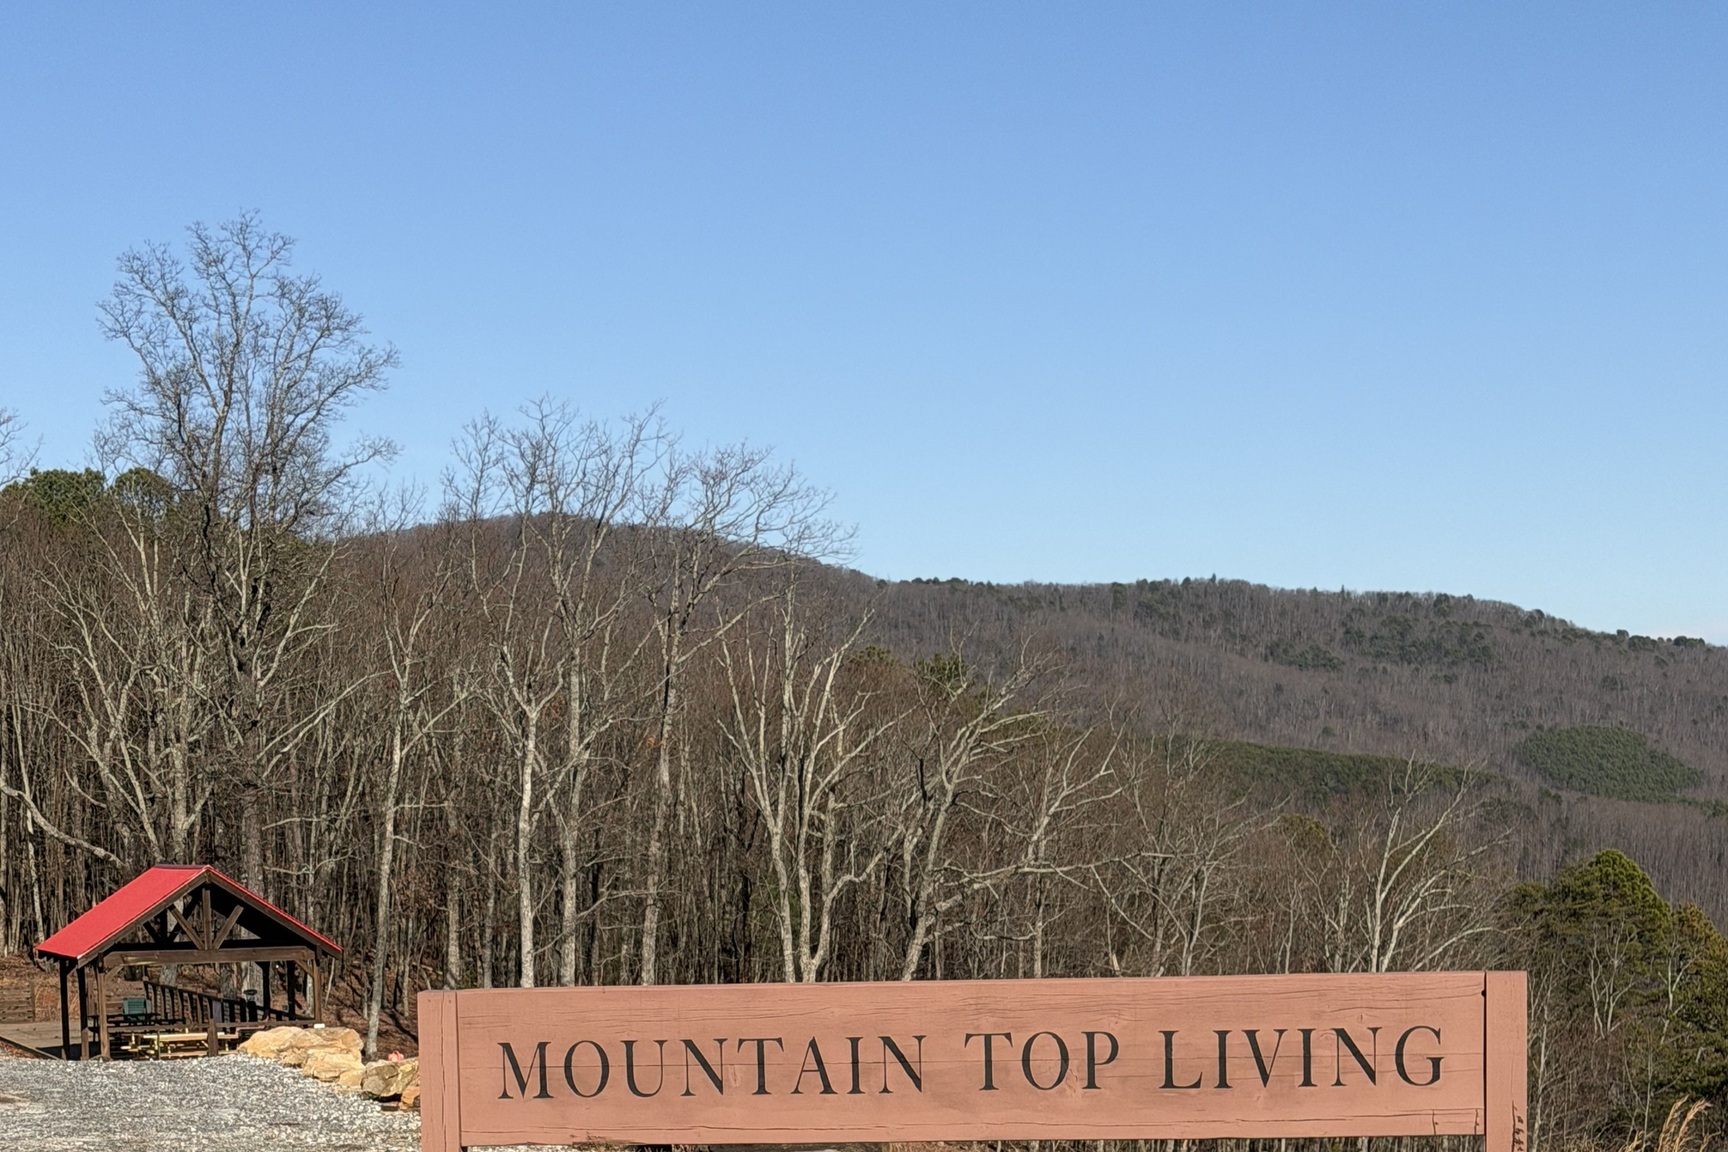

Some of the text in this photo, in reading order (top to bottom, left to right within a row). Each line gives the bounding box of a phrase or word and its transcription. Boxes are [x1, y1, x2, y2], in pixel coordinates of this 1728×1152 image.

[497, 1025, 1446, 1100] MOUNTAIN TOP LIVING
